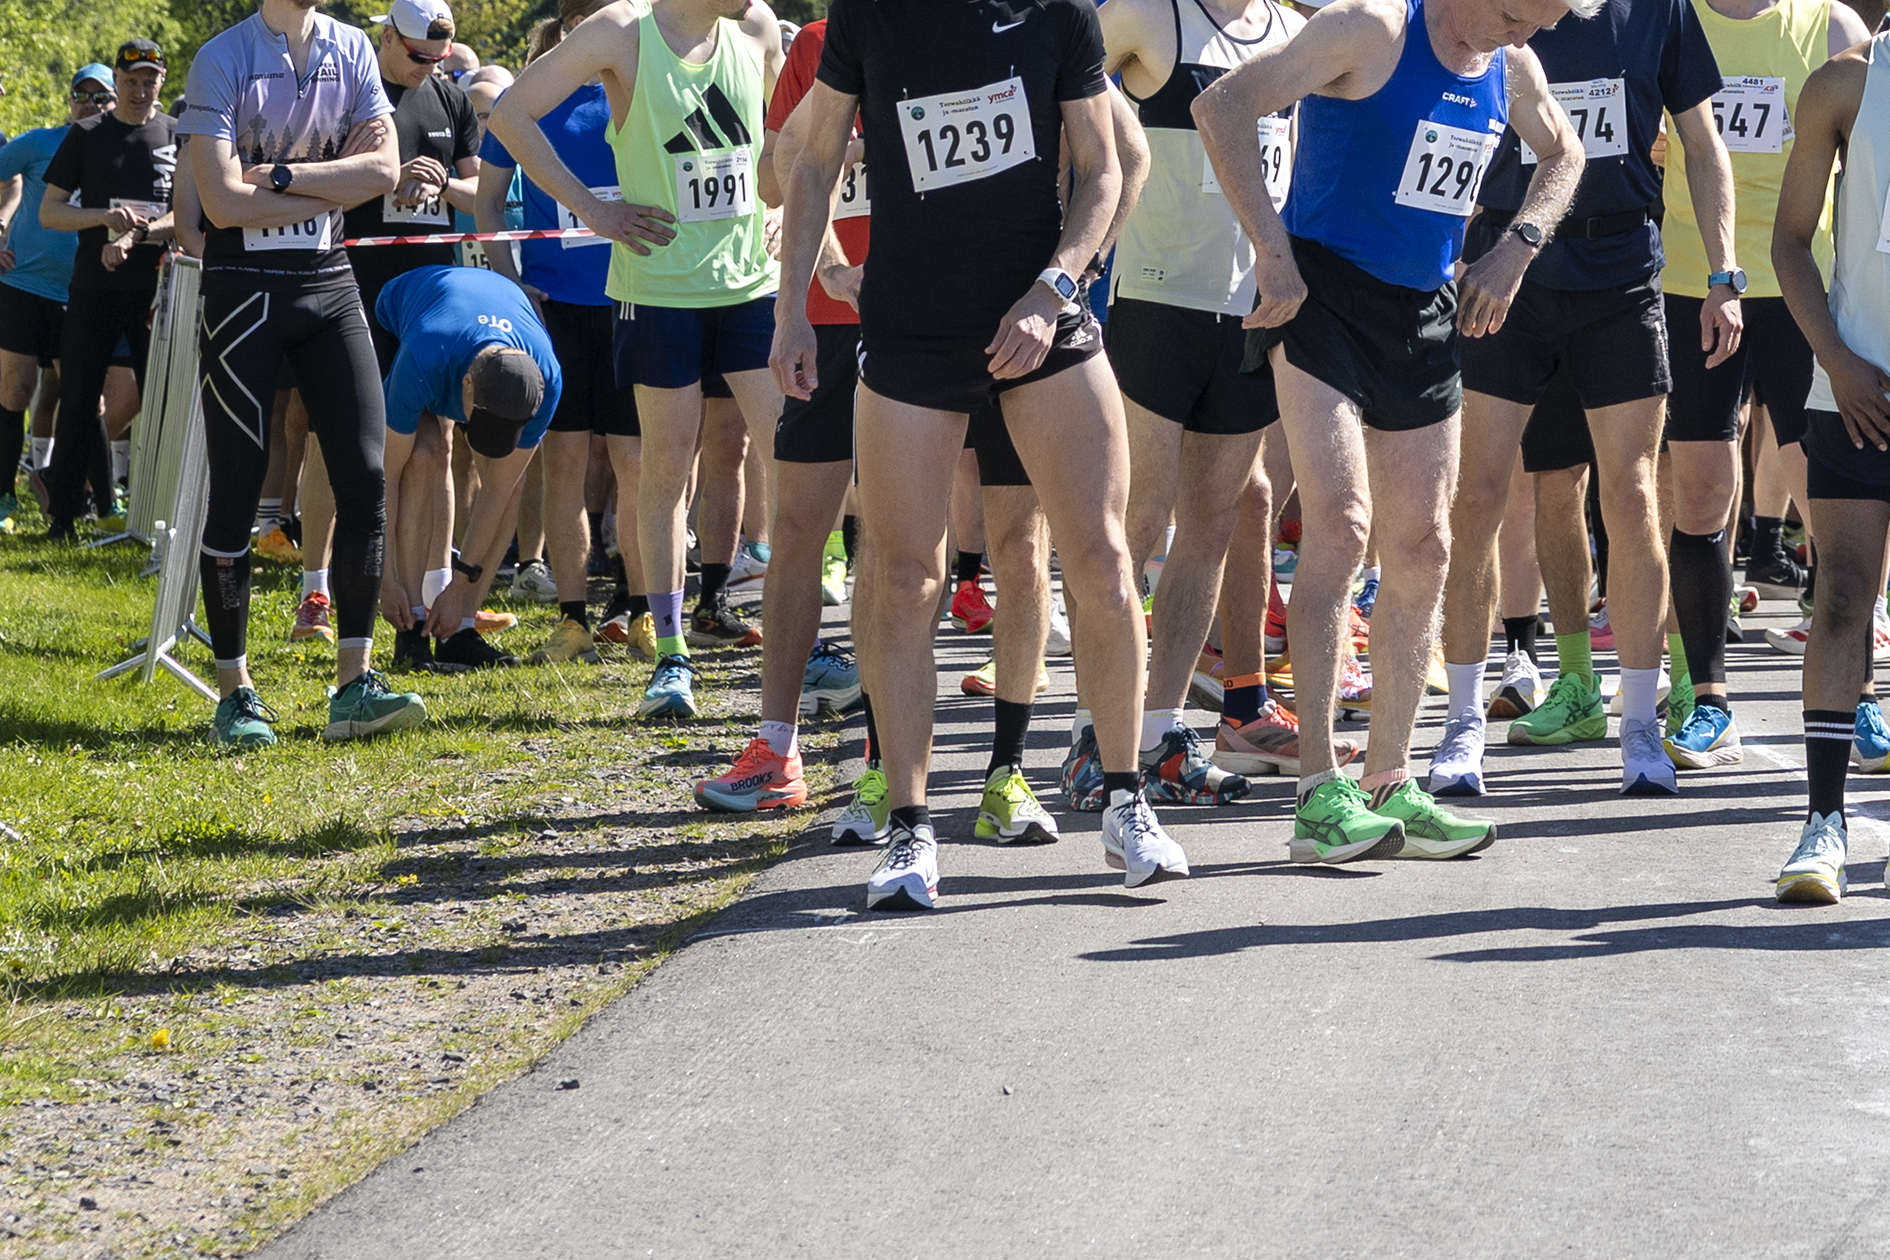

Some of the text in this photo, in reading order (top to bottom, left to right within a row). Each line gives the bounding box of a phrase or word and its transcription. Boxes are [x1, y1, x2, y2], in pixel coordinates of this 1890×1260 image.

[987, 88, 1014, 104] ymca
[1588, 87, 1612, 97] 4212
[1742, 78, 1764, 86] 4481
[1442, 91, 1471, 107] CRAFT
[1570, 106, 1615, 144] 74
[1711, 102, 1771, 138] 547
[917, 112, 1015, 173] 1239
[1261, 144, 1282, 183] 69
[688, 172, 747, 210] 1991
[730, 771, 774, 792] BROOKS
